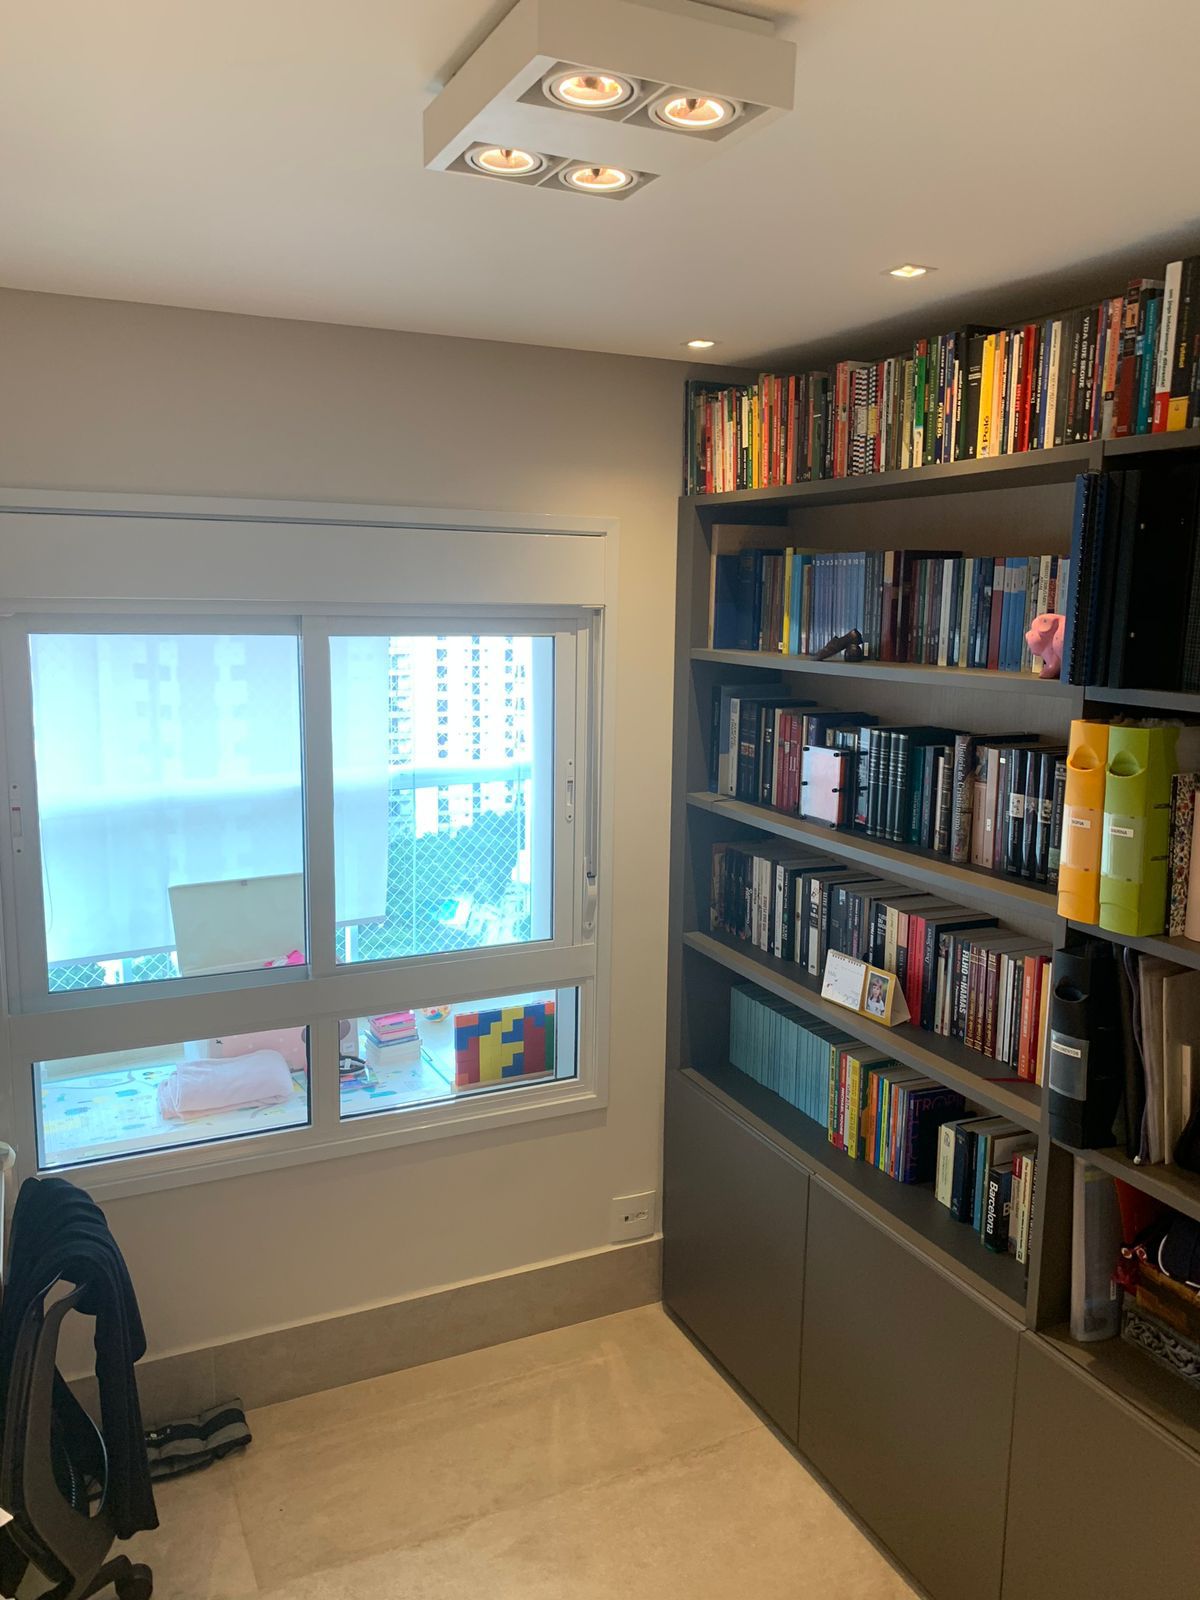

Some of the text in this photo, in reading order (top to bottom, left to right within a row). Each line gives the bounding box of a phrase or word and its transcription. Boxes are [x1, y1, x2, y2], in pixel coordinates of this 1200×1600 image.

[1163, 316, 1172, 356] inteiramente
[1178, 342, 1187, 368] Futebol
[958, 743, 966, 771] História
[954, 782, 965, 830] Cristianismo
[959, 981, 968, 1014] HAMAS
[986, 1181, 998, 1235] Barcelona
